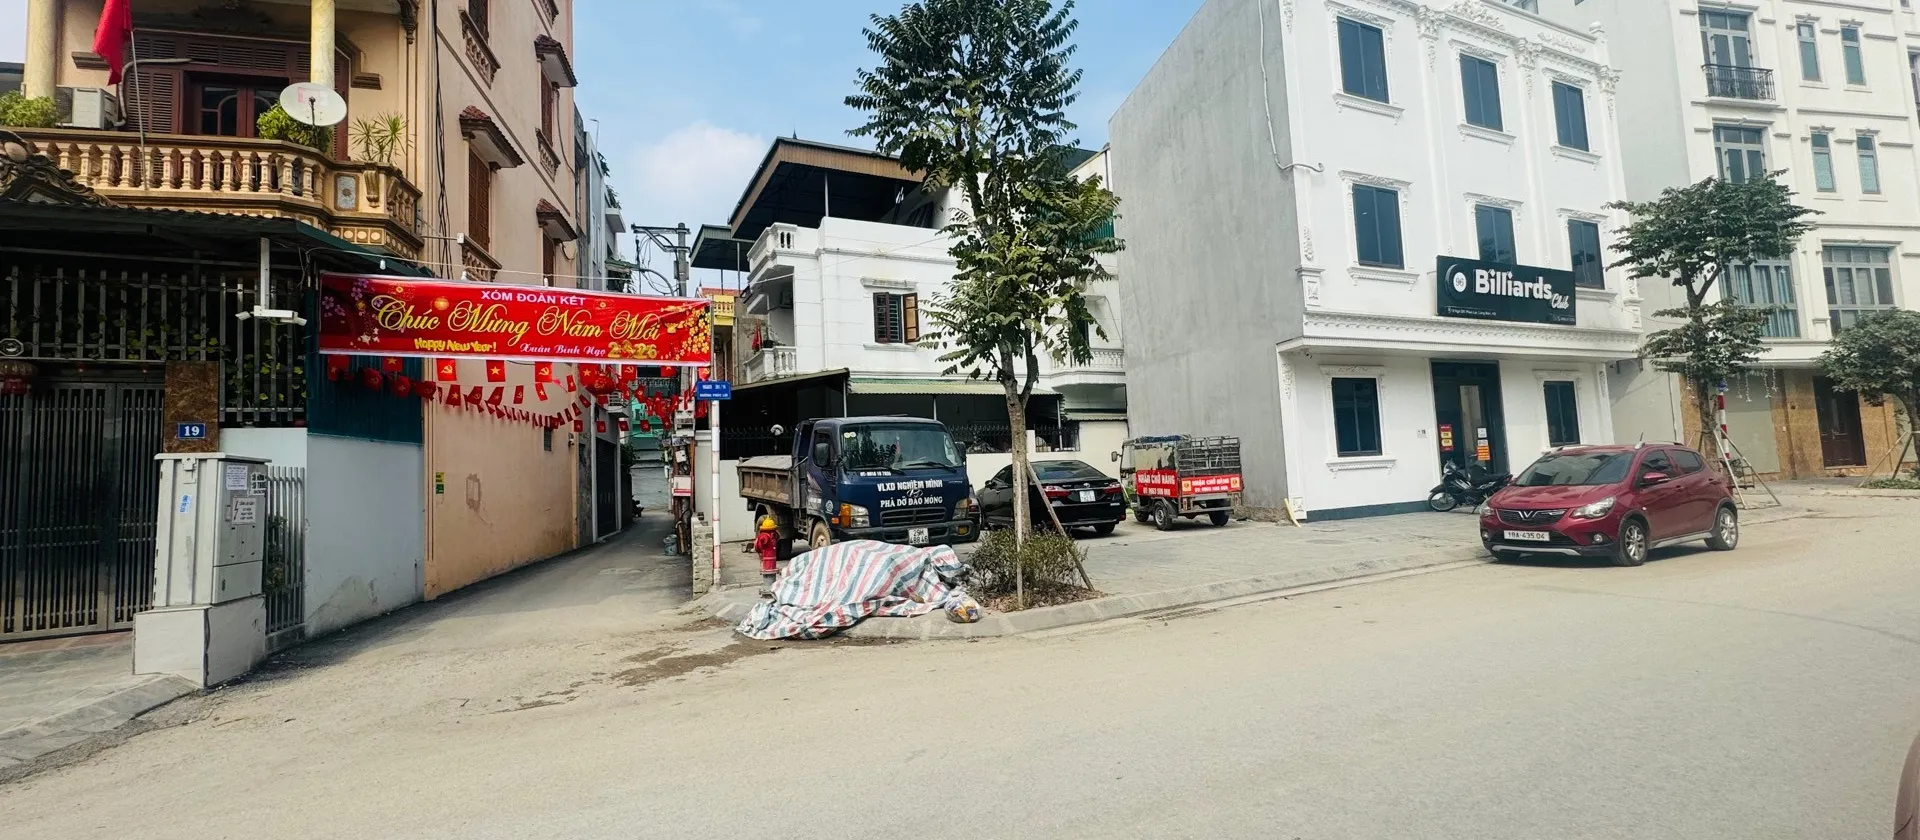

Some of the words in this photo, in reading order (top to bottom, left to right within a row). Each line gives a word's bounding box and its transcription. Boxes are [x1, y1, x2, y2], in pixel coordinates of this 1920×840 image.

[1456, 277, 1465, 287] 96
[1475, 268, 1552, 300] Billiards
[481, 289, 512, 301] XÓM
[517, 293, 556, 304] ĐOÀN
[1551, 292, 1570, 309] Club
[371, 295, 440, 331] Chúc
[448, 300, 530, 347] Mừng
[537, 305, 604, 337] Năm
[609, 310, 661, 341] Mới
[414, 337, 446, 352] Happy
[446, 339, 471, 352] New
[470, 340, 497, 353] Year!
[519, 343, 551, 354] Xuân
[583, 345, 606, 357] Ngọ
[184, 425, 200, 437] 19
[877, 482, 896, 492] VLXD
